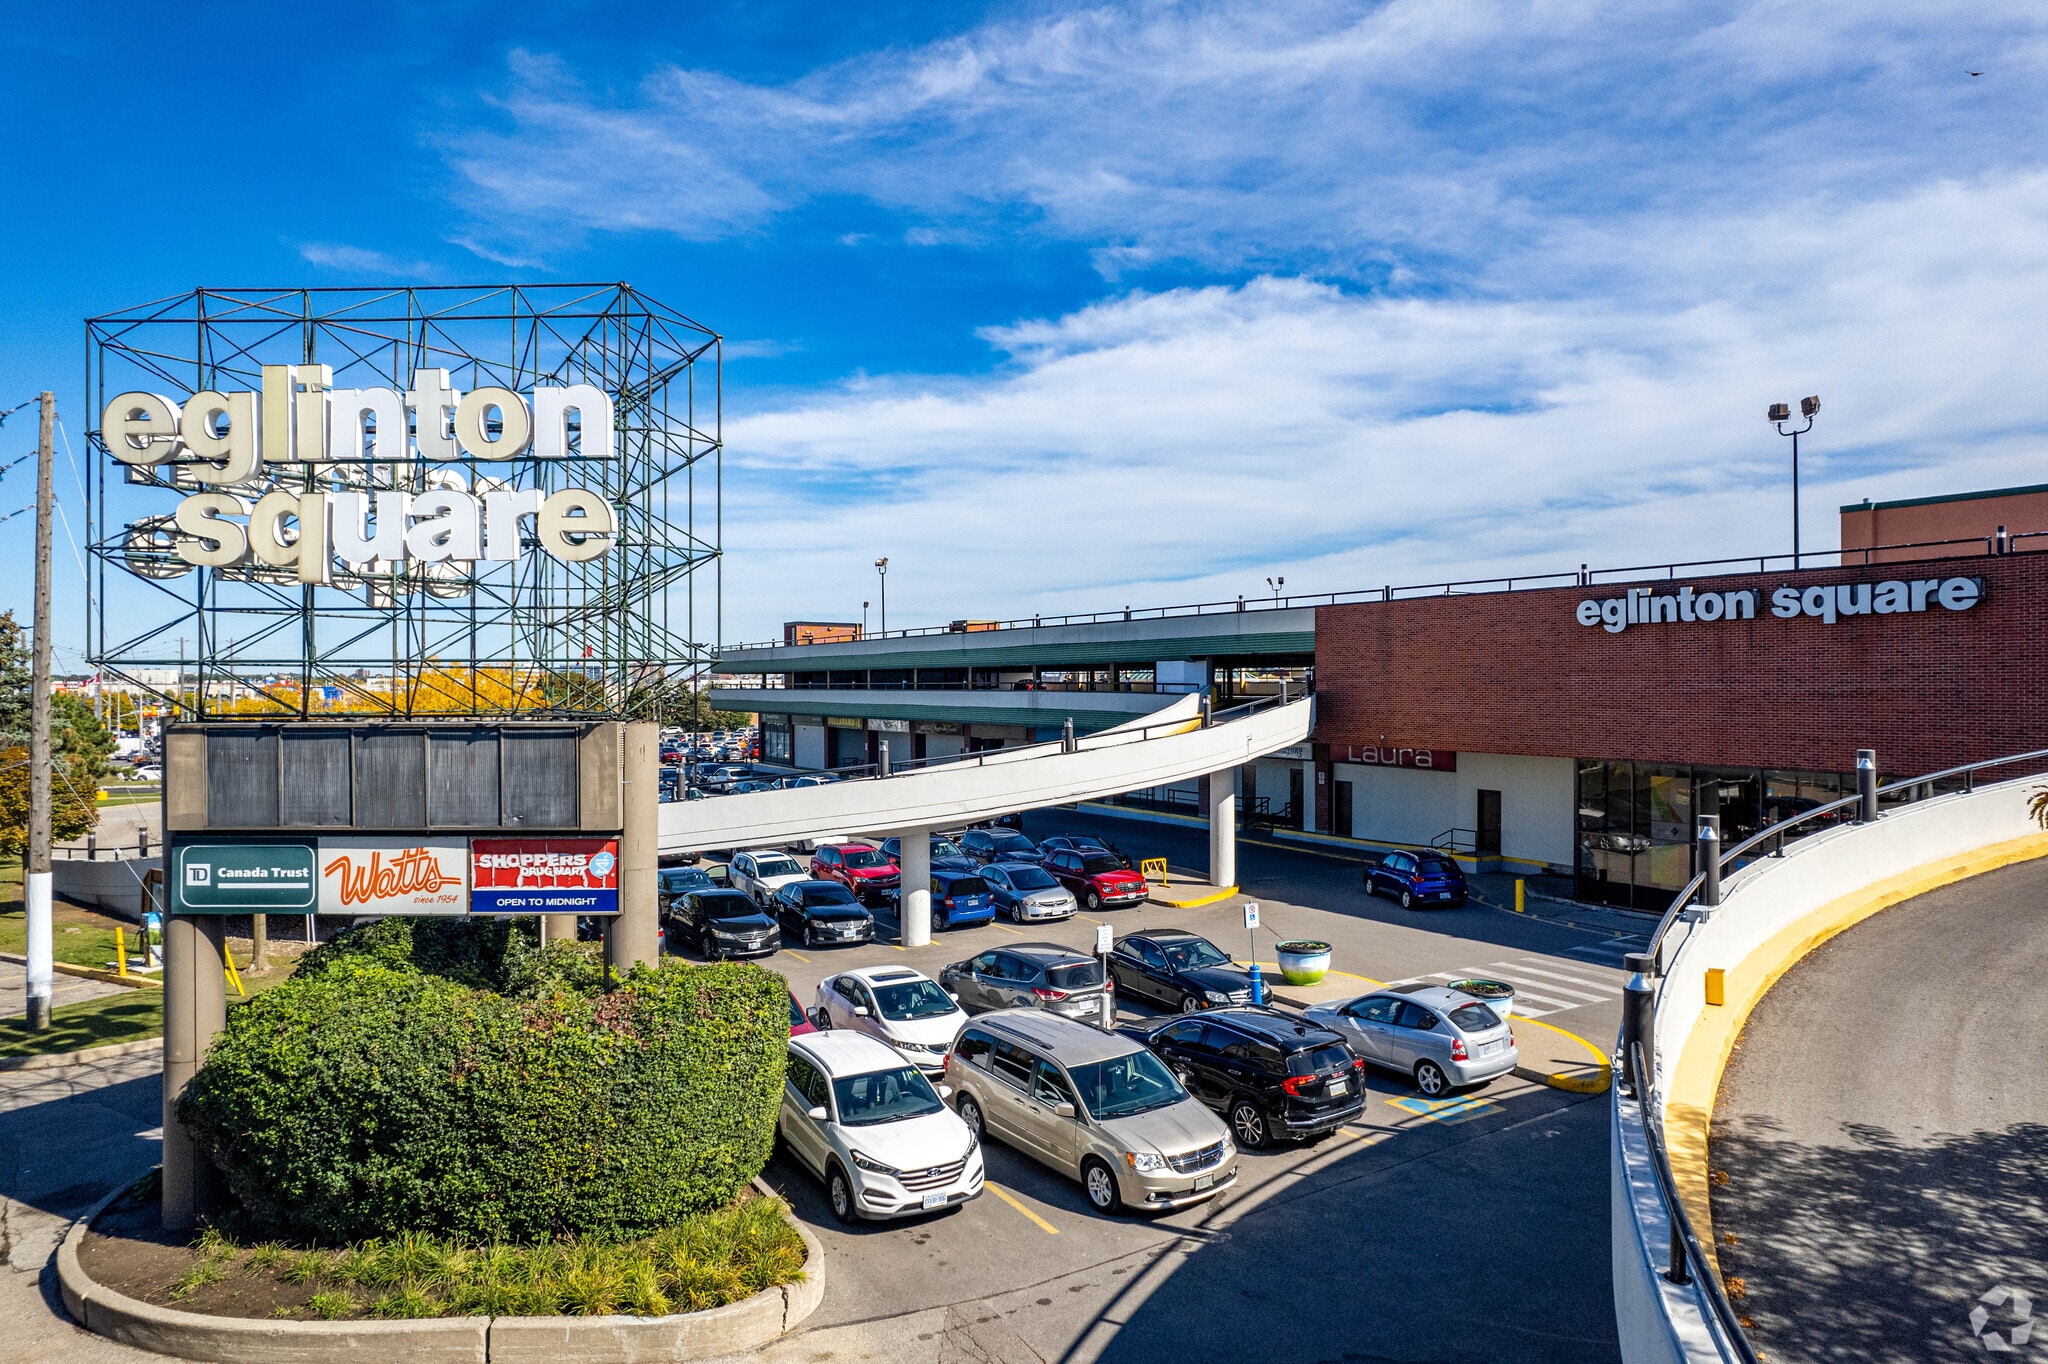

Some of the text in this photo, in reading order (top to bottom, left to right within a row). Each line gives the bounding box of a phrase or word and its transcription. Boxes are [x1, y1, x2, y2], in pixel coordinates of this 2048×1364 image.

[101, 363, 617, 486] eglinton
[175, 488, 618, 585] square
[1575, 575, 1982, 634] eglinton square
[1348, 744, 1433, 768] Laura
[479, 854, 587, 868] SHOPPERS
[521, 865, 587, 877] DRUG MART
[189, 866, 310, 882] TD Canada Trust
[324, 847, 461, 906] Watts
[413, 894, 458, 904] since 1954
[496, 897, 597, 907] OPEN TO MIDNIGHT
